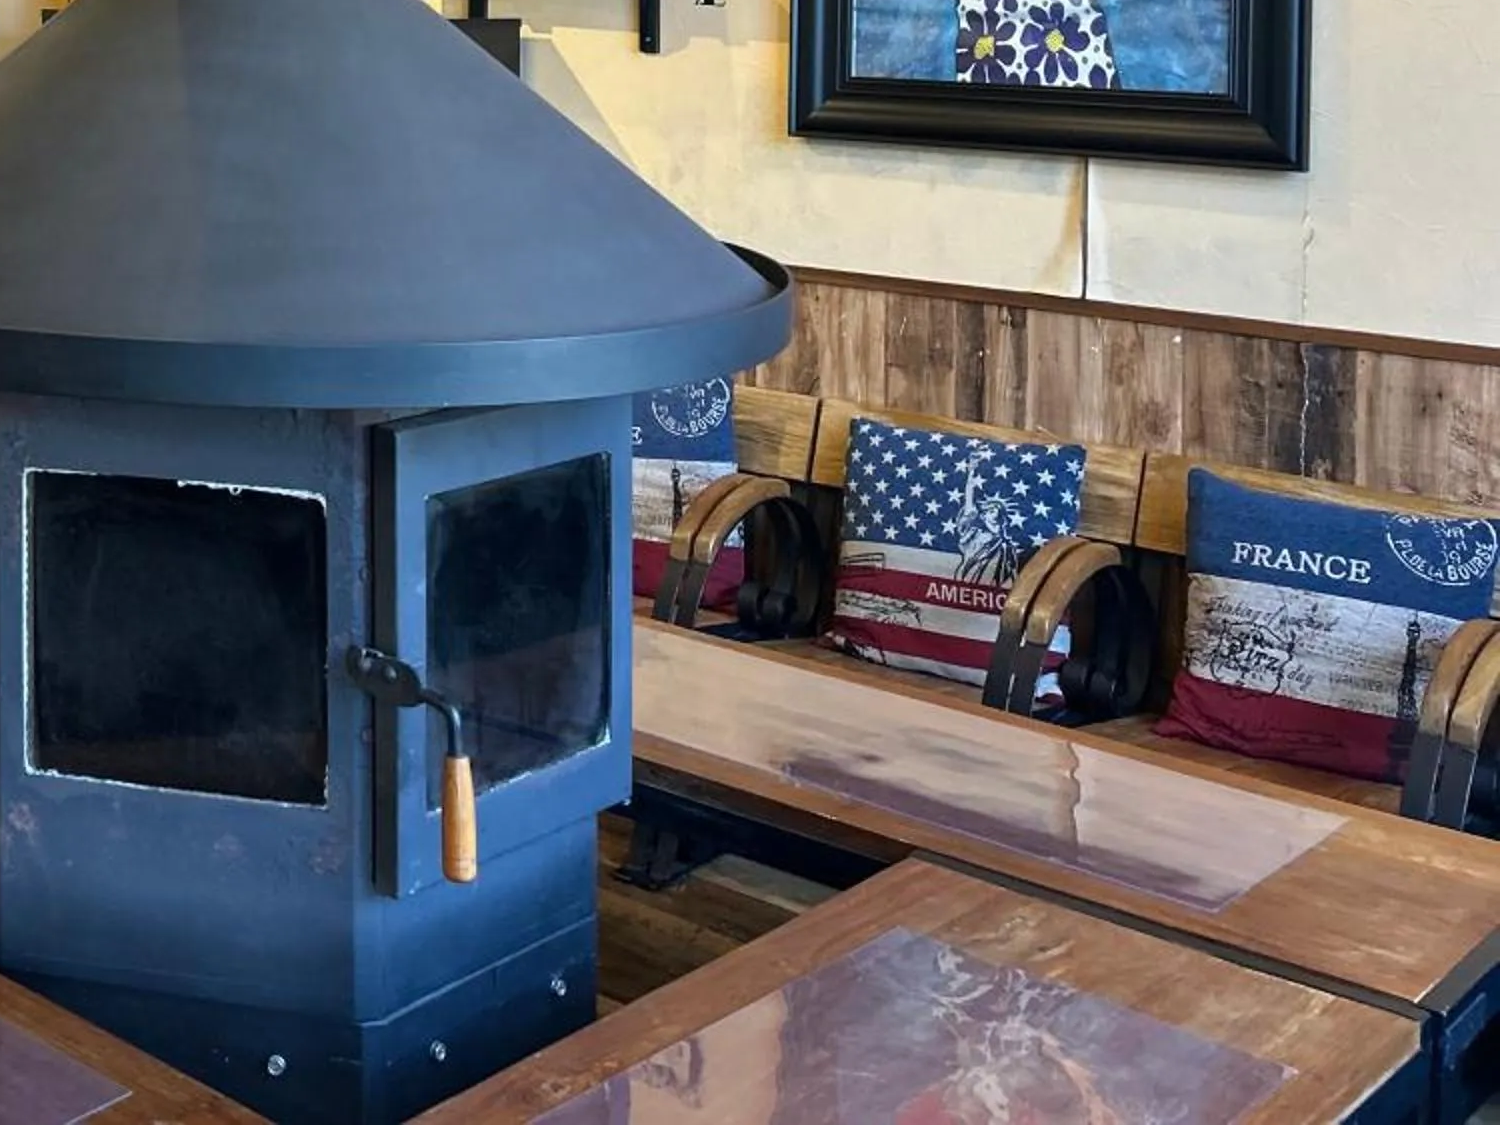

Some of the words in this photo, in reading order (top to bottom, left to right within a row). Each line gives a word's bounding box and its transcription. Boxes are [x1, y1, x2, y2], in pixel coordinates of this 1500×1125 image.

[1232, 540, 1372, 584] FRANCE
[1447, 540, 1493, 582] BOURSE
[925, 581, 1009, 611] AMERIC
